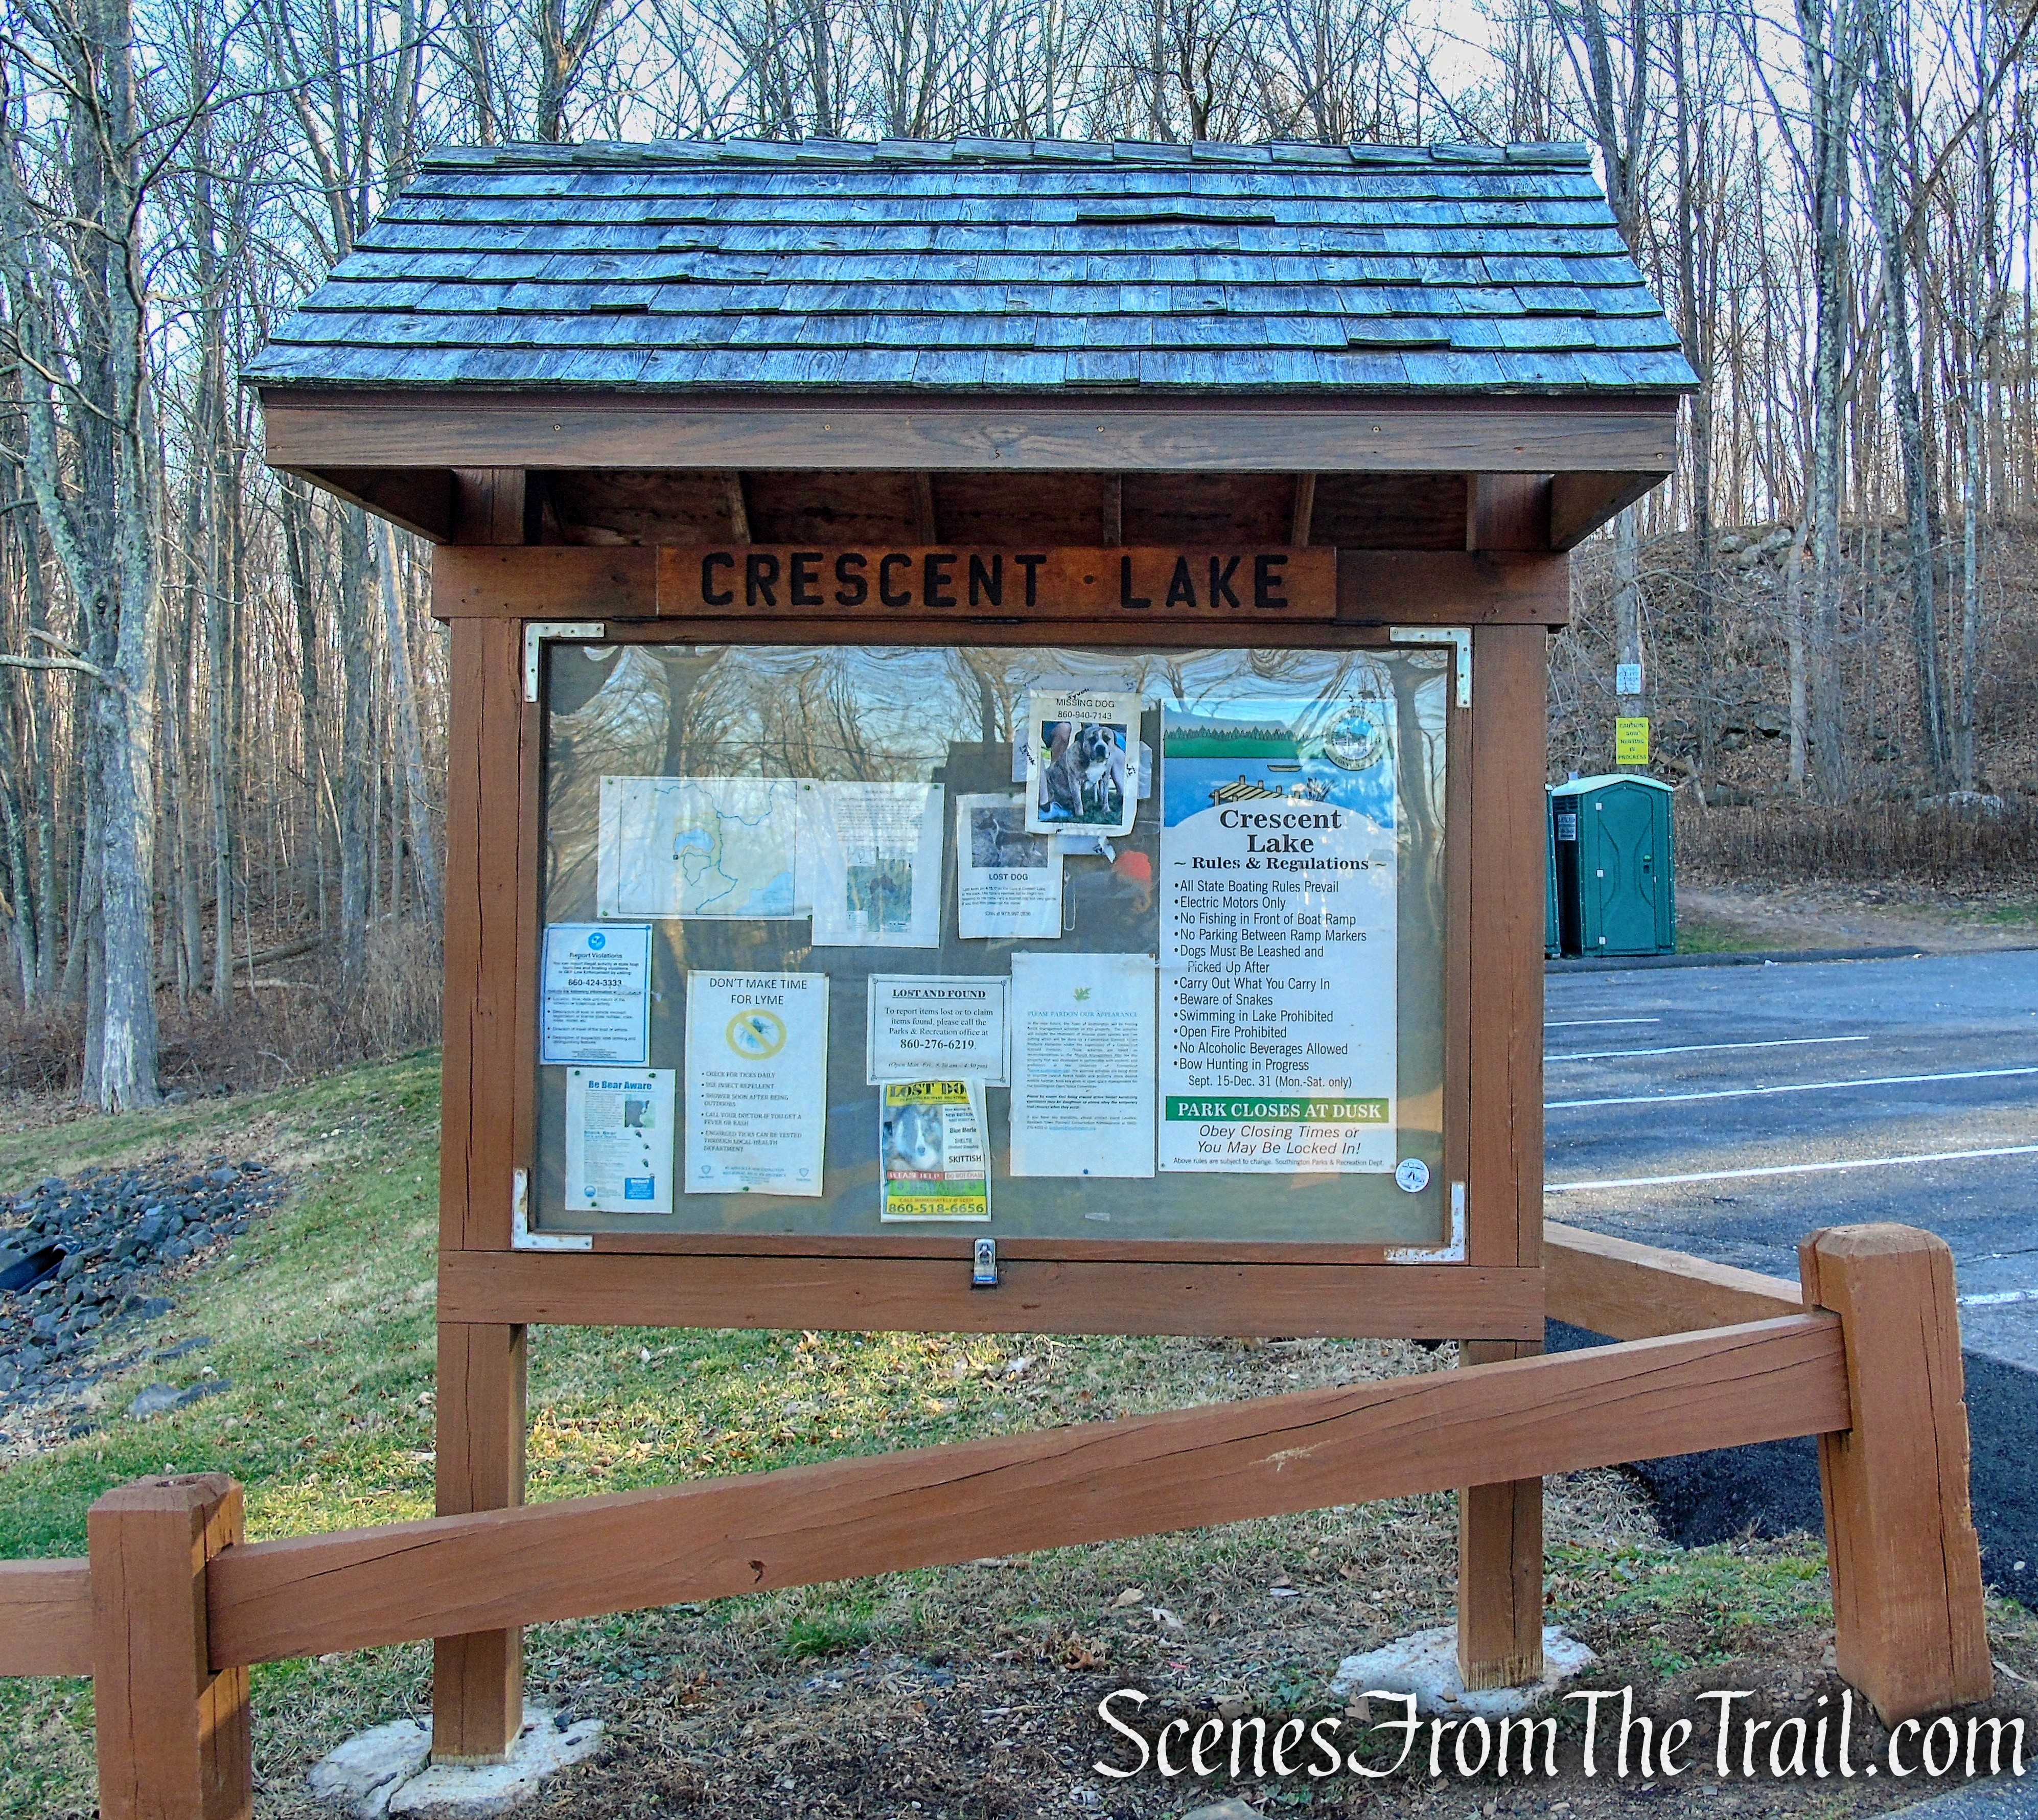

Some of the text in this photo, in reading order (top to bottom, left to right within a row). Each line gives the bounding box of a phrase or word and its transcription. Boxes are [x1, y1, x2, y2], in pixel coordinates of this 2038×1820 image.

[701, 551, 1289, 608] CRESCENT LAKE
[1055, 698, 1092, 706] MISSING
[1058, 710, 1111, 719] 860-940-7143
[1220, 810, 1341, 828] Crescent
[1247, 834, 1313, 853] Lake
[1192, 857, 1368, 872] Rules & Regulations
[1180, 880, 1338, 894] All State Boating Rules Prevail
[1180, 895, 1286, 911] Electric Motors Only
[1180, 912, 1355, 927] No Fishing in Front of Boat Ramp
[1180, 928, 1366, 943] No Parking Between Ramp Markers
[1180, 944, 1323, 959] Dogs Must Be Leashed and
[1188, 961, 1269, 975] Picked Up After
[710, 978, 806, 989] DON'T MAKE TIME
[1180, 977, 1329, 991] Carry Out What You Carry In
[731, 995, 783, 1004] FOR LYME
[1180, 993, 1272, 1005] Beware of Snakes
[937, 1018, 958, 1026] please
[1179, 1009, 1333, 1023] Swimming in Lake Prohibited
[1179, 1025, 1286, 1039] Open Fire Prohibited
[1180, 1042, 1347, 1056] No Alcoholic Beverages Allowed
[1180, 1057, 1309, 1072] Bow Hunting in Progress
[601, 1080, 622, 1089] Bear
[1189, 1075, 1212, 1088] Sept.
[1259, 1075, 1270, 1086] 31
[1276, 1076, 1325, 1087] (Mon.-Sat.
[1329, 1076, 1351, 1089] only)
[889, 1082, 935, 1097] LOST
[1178, 1102, 1381, 1118] PARK CLOSES AT DUSK
[1200, 1124, 1359, 1140] Obey Closing Times or
[1198, 1141, 1360, 1155] You May Be Locked In!
[889, 1203, 984, 1213] 860-518-6656
